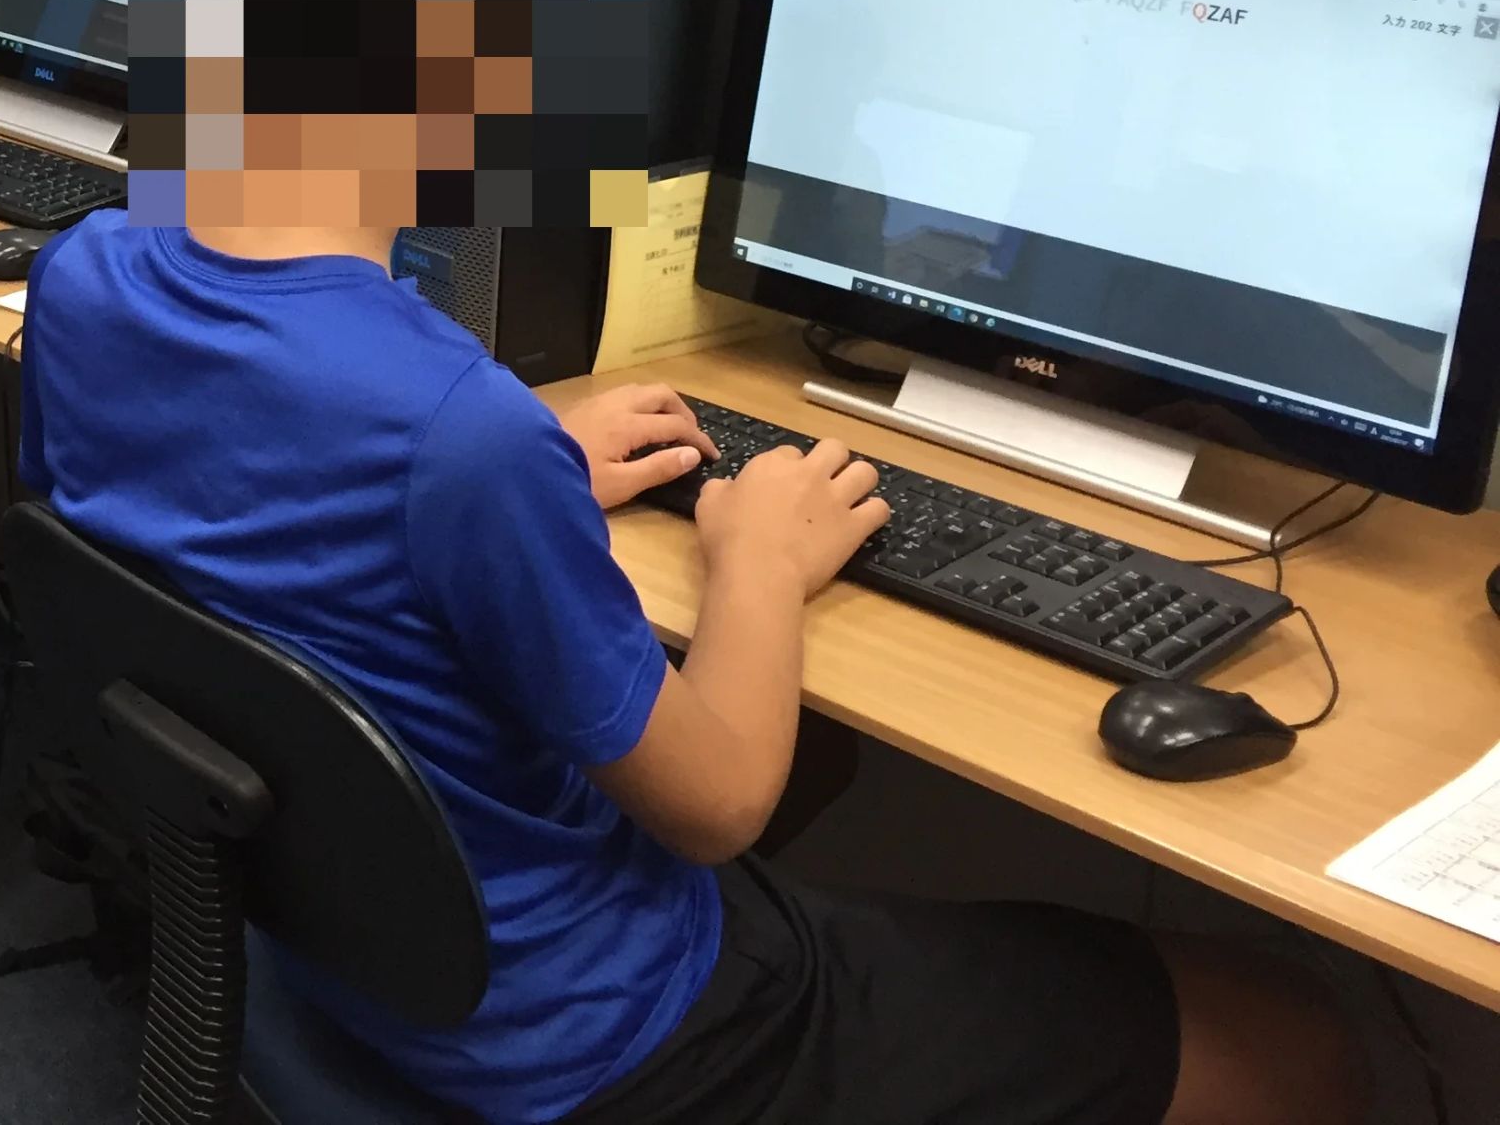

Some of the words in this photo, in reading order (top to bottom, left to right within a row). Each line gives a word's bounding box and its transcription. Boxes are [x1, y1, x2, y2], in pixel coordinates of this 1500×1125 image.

[1180, 0, 1249, 25] FQZAF
[1382, 13, 1407, 29] 入力
[1410, 19, 1434, 32] 202
[1436, 22, 1462, 37] 文字
[1014, 355, 1059, 379] DELL
